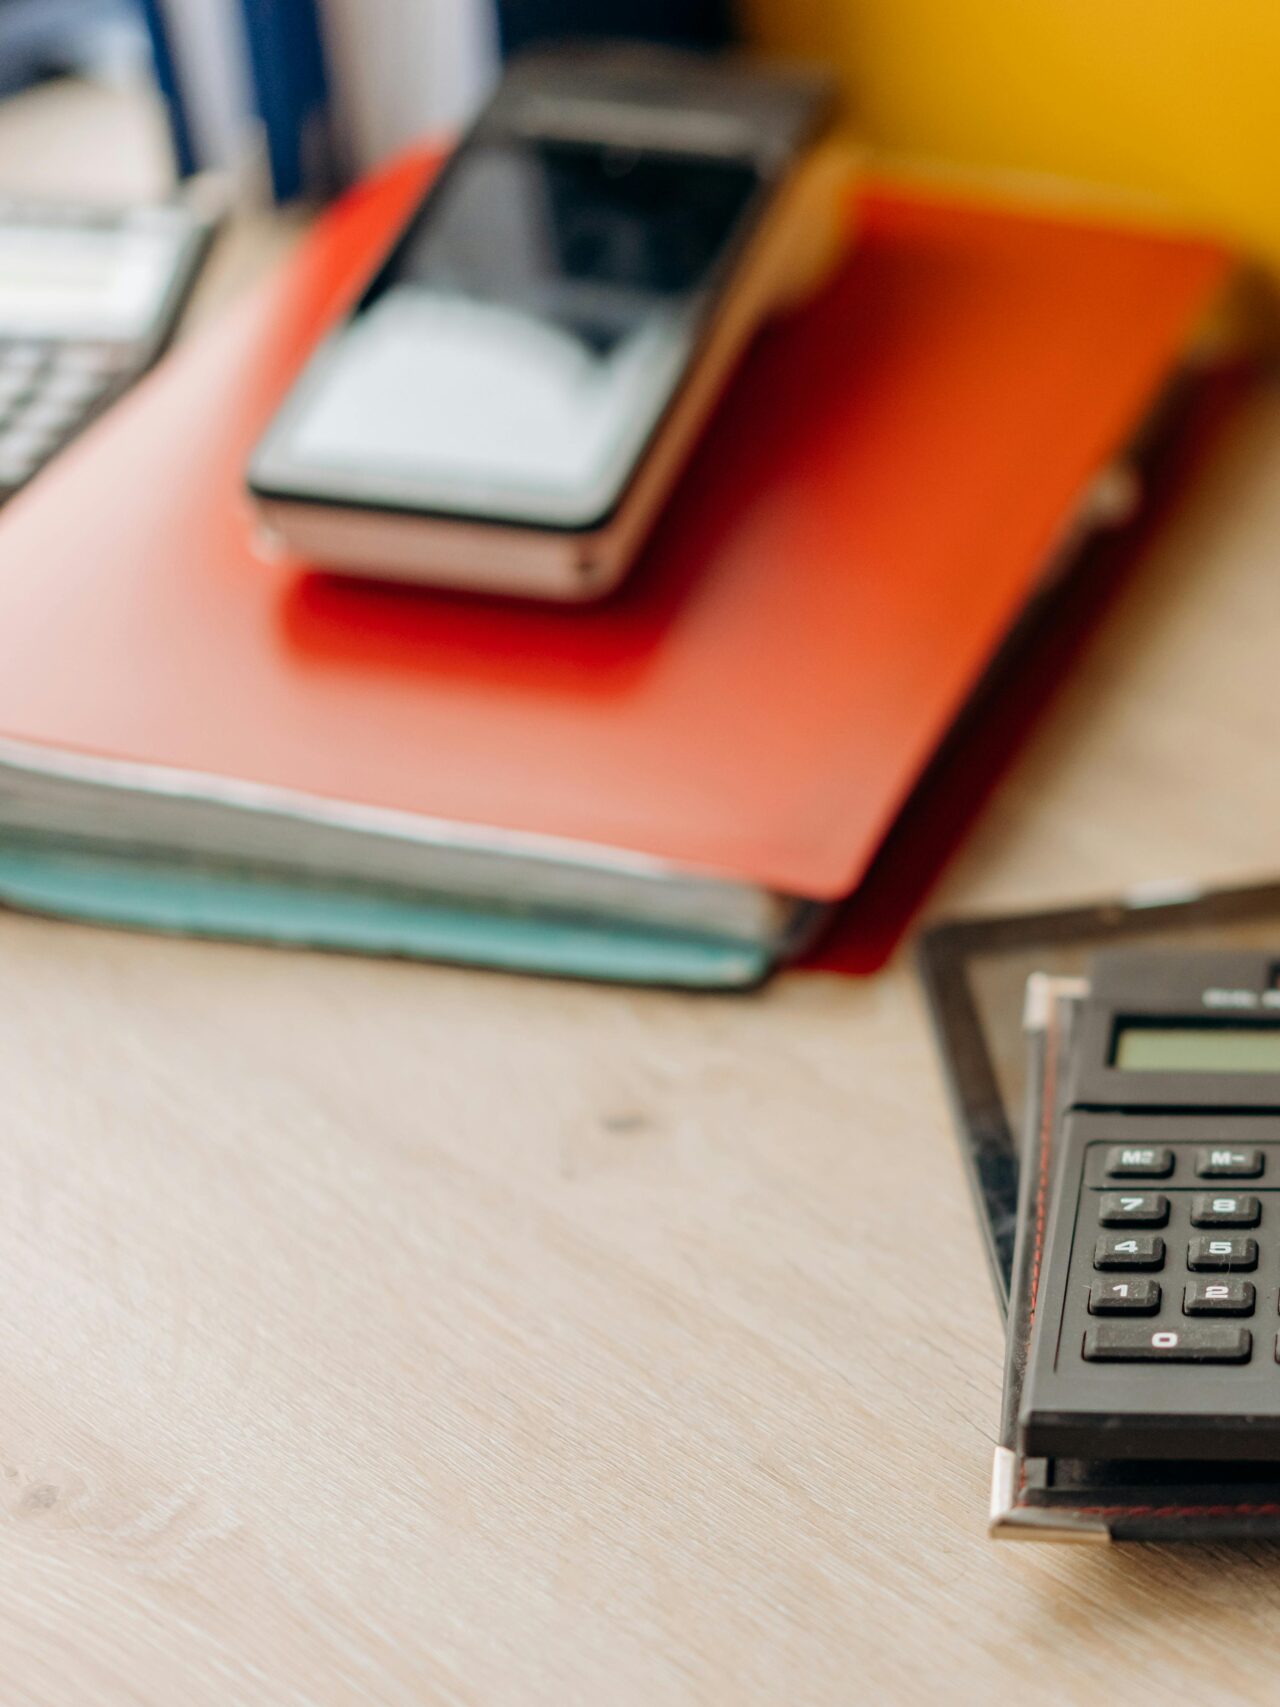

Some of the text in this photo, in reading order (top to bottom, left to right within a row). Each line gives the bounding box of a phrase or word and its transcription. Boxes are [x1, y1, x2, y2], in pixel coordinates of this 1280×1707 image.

[1120, 1197, 1144, 1211] 7
[1212, 1199, 1236, 1212] 8
[1114, 1240, 1139, 1253] 4
[1208, 1241, 1232, 1254] 5
[1112, 1284, 1128, 1297] 1
[1205, 1286, 1229, 1299] 2
[1151, 1332, 1178, 1348] 0
